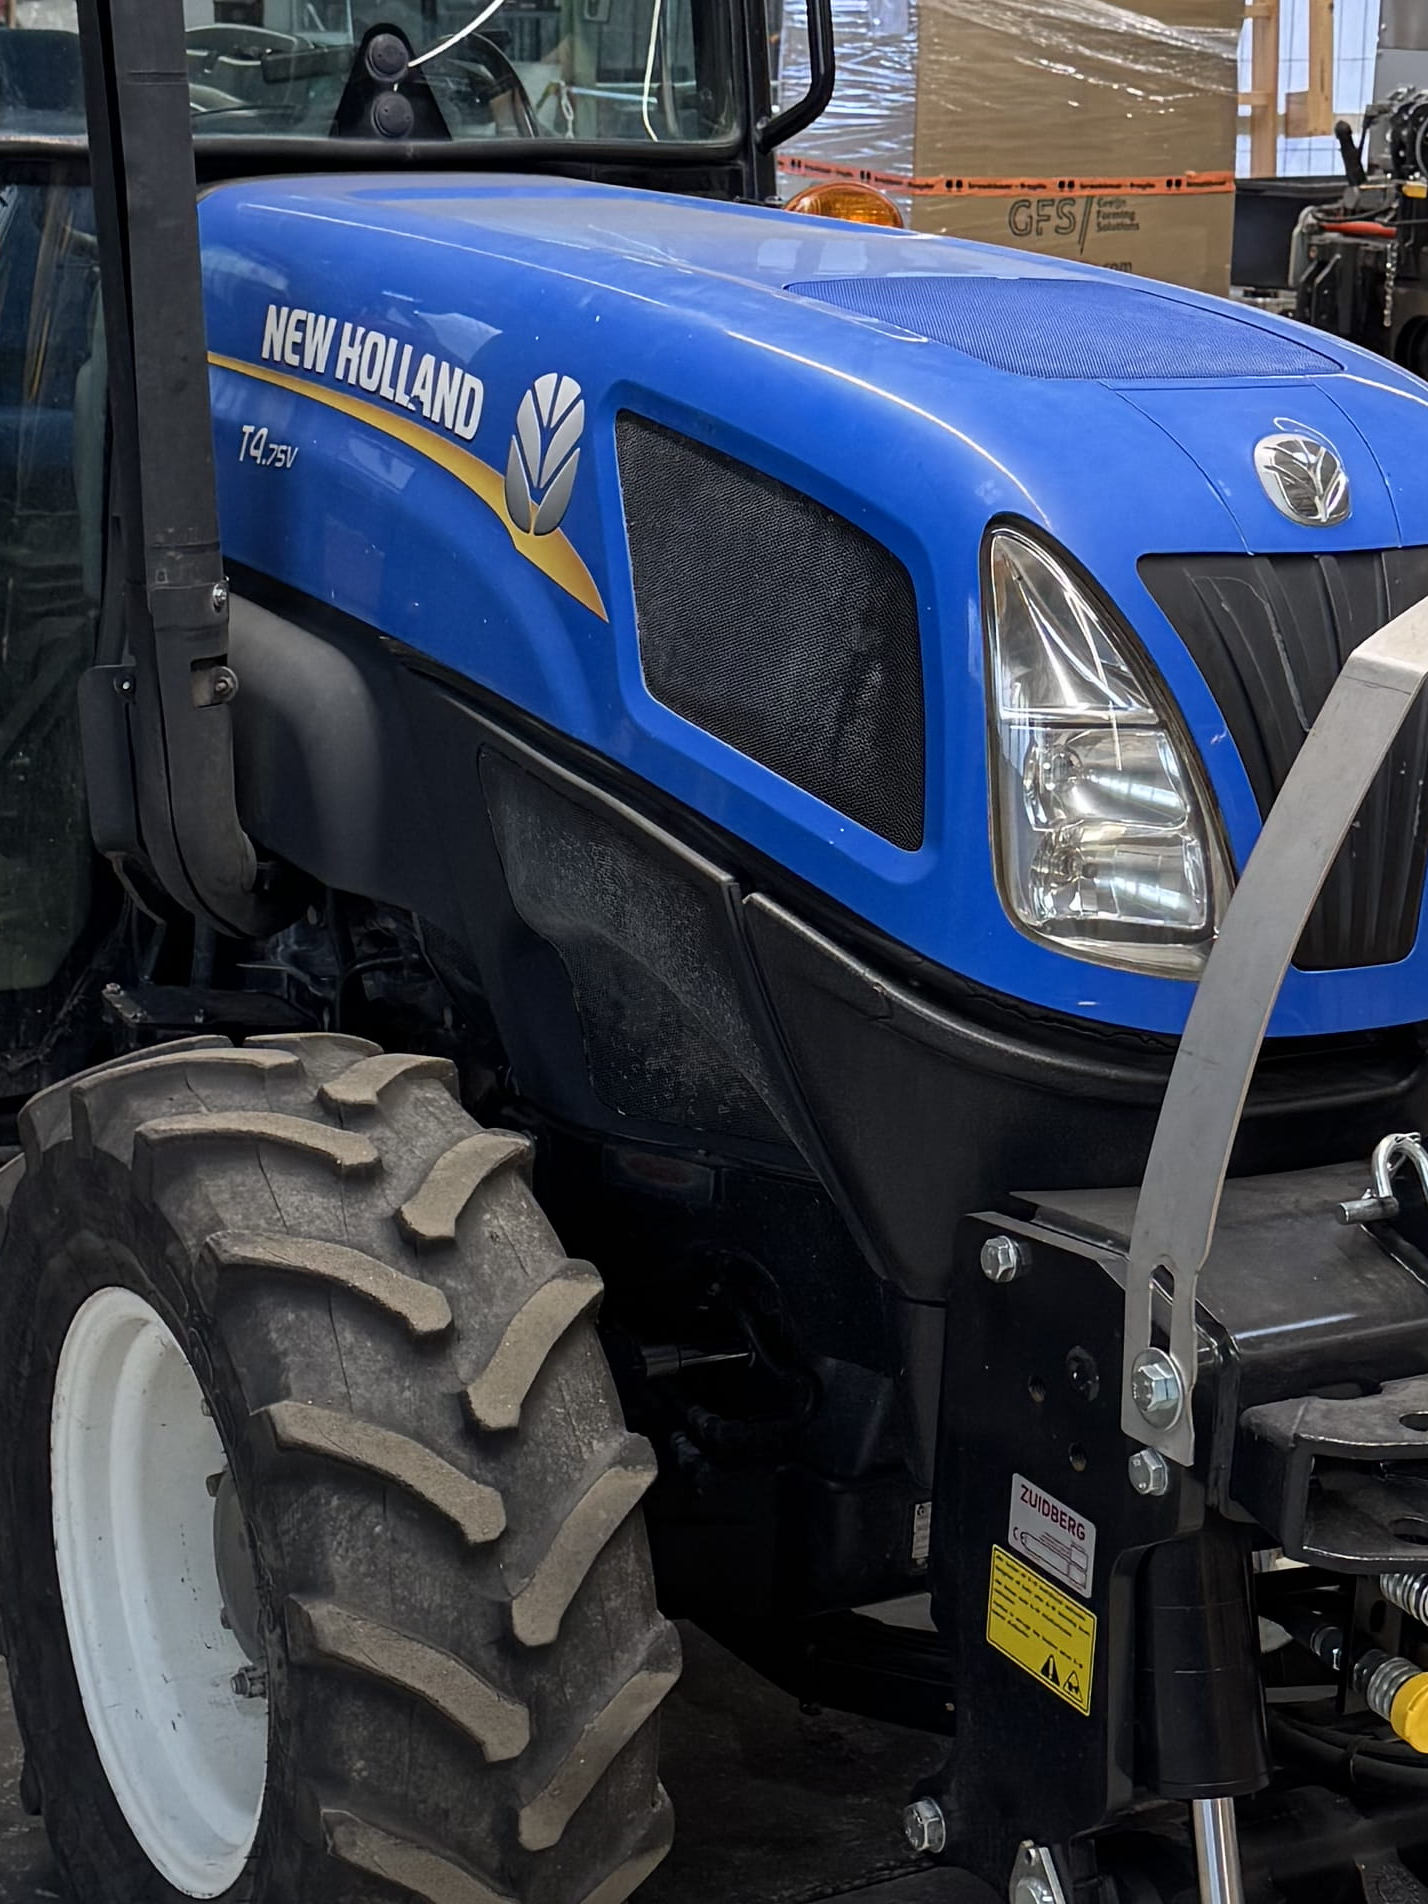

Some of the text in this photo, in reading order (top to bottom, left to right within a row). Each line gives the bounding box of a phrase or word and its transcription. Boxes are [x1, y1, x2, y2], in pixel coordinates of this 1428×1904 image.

[1008, 197, 1076, 237] GFS
[261, 304, 485, 441] NEW HOLLAND
[239, 424, 299, 469] T4.75V
[1020, 1484, 1086, 1542] ZUIDBERG
